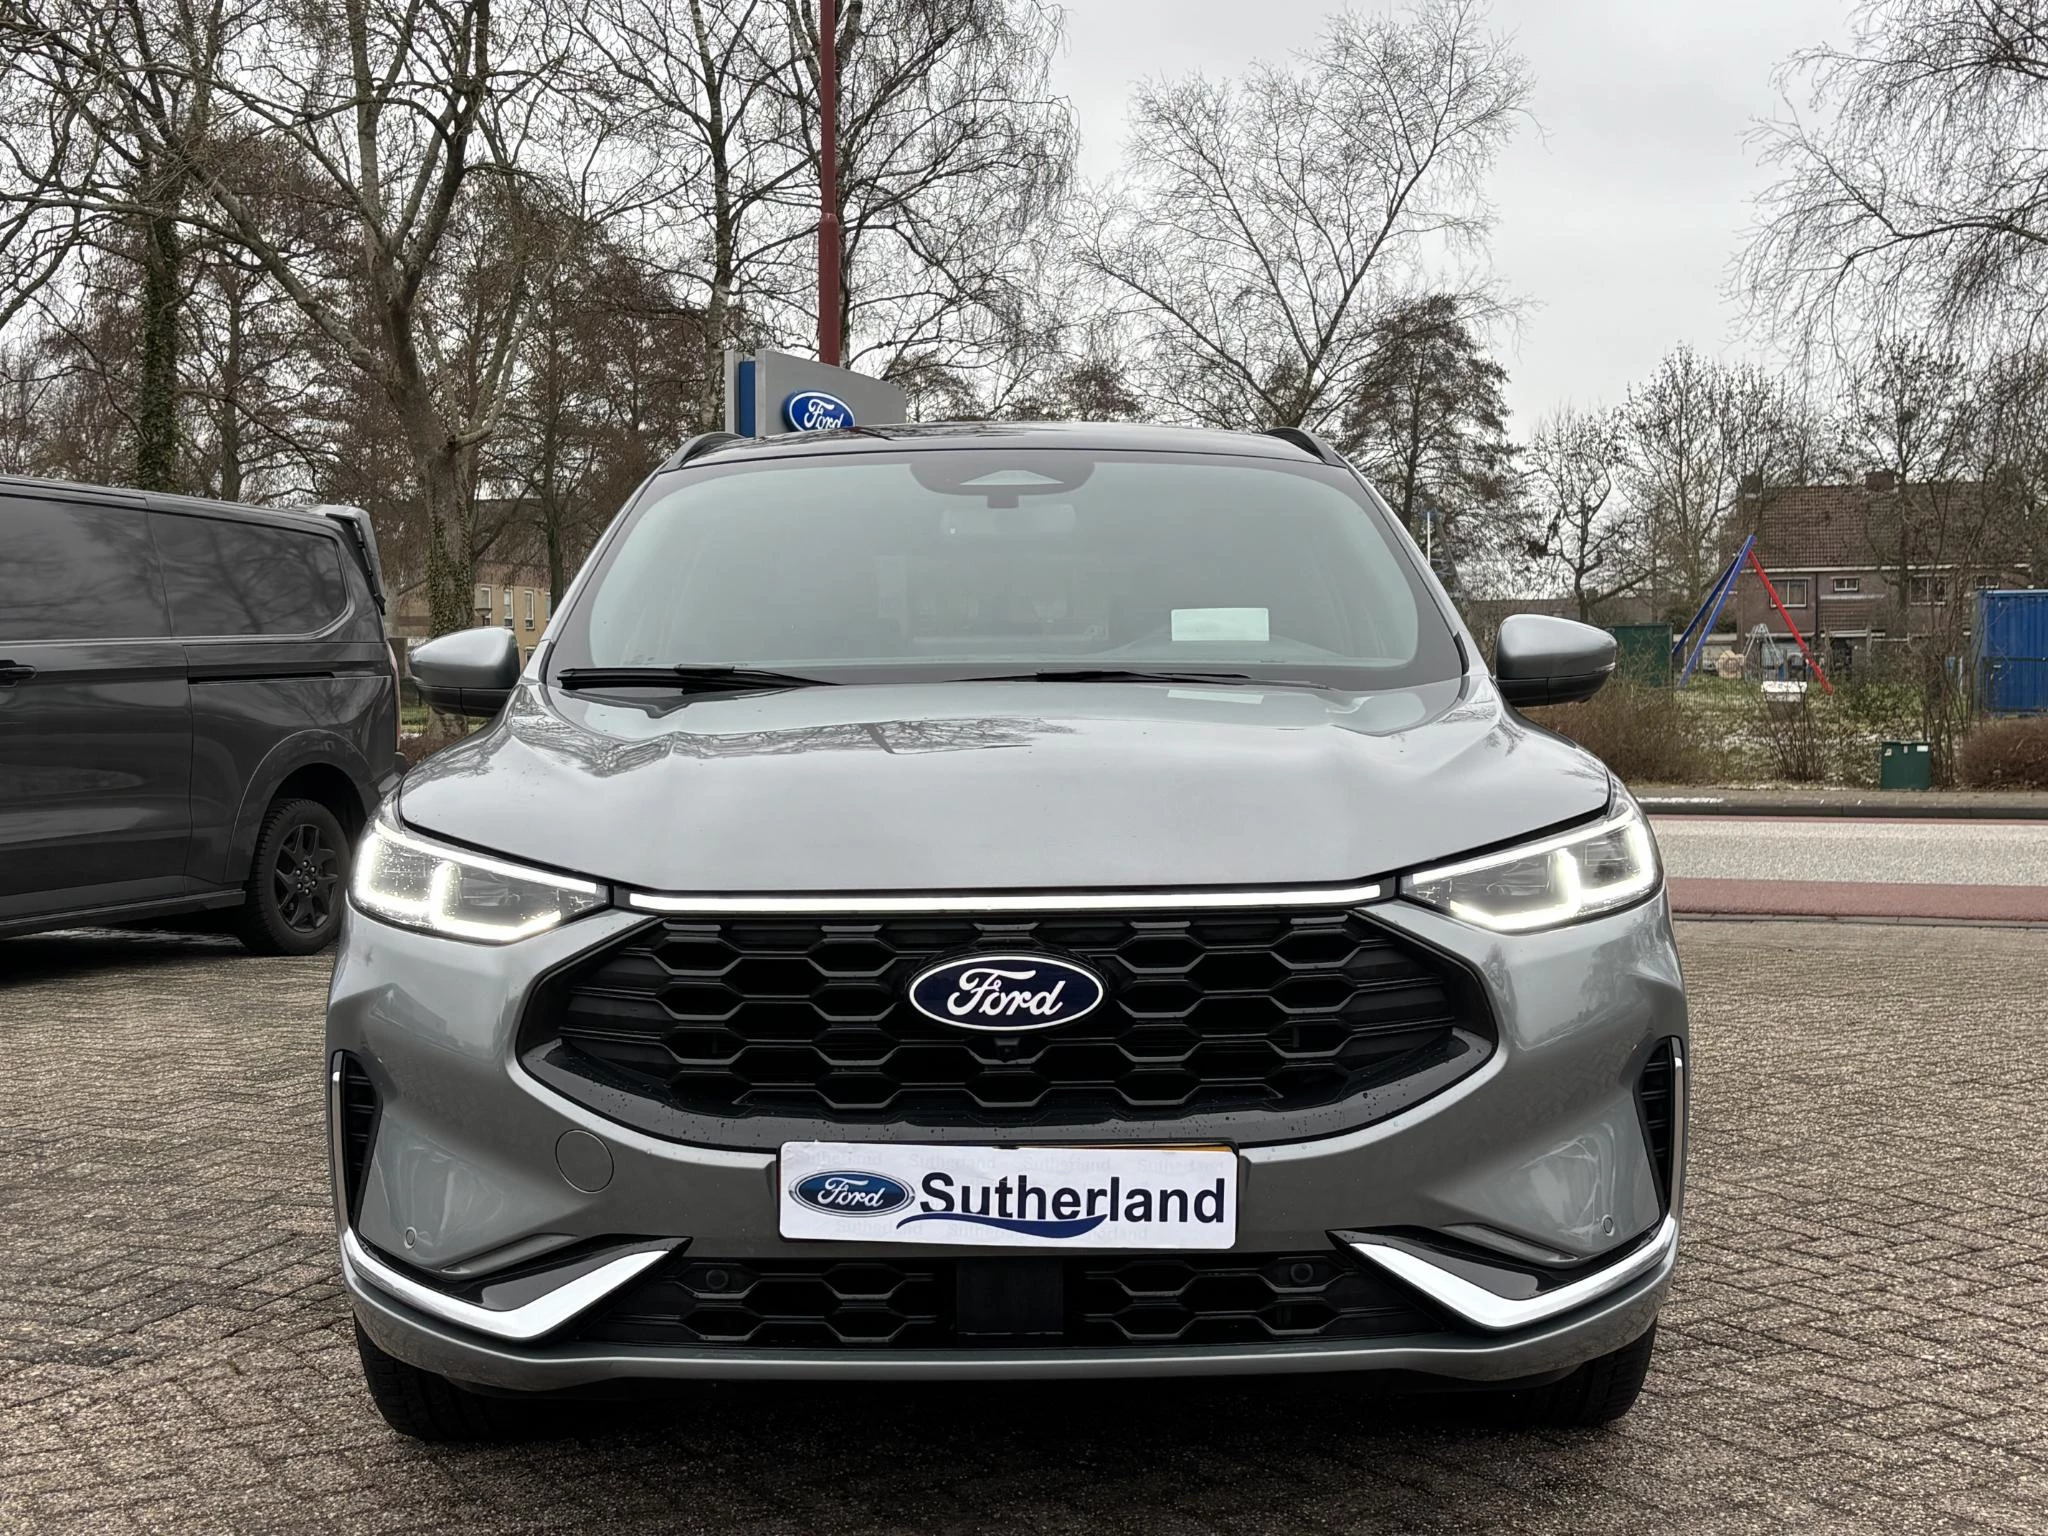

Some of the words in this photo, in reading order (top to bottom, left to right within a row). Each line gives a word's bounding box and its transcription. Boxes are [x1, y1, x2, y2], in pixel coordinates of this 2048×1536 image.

[804, 398, 844, 428] Ford
[947, 967, 1066, 1016] Ford
[818, 1177, 885, 1209] Ford
[920, 1171, 1226, 1224] Sutherland
